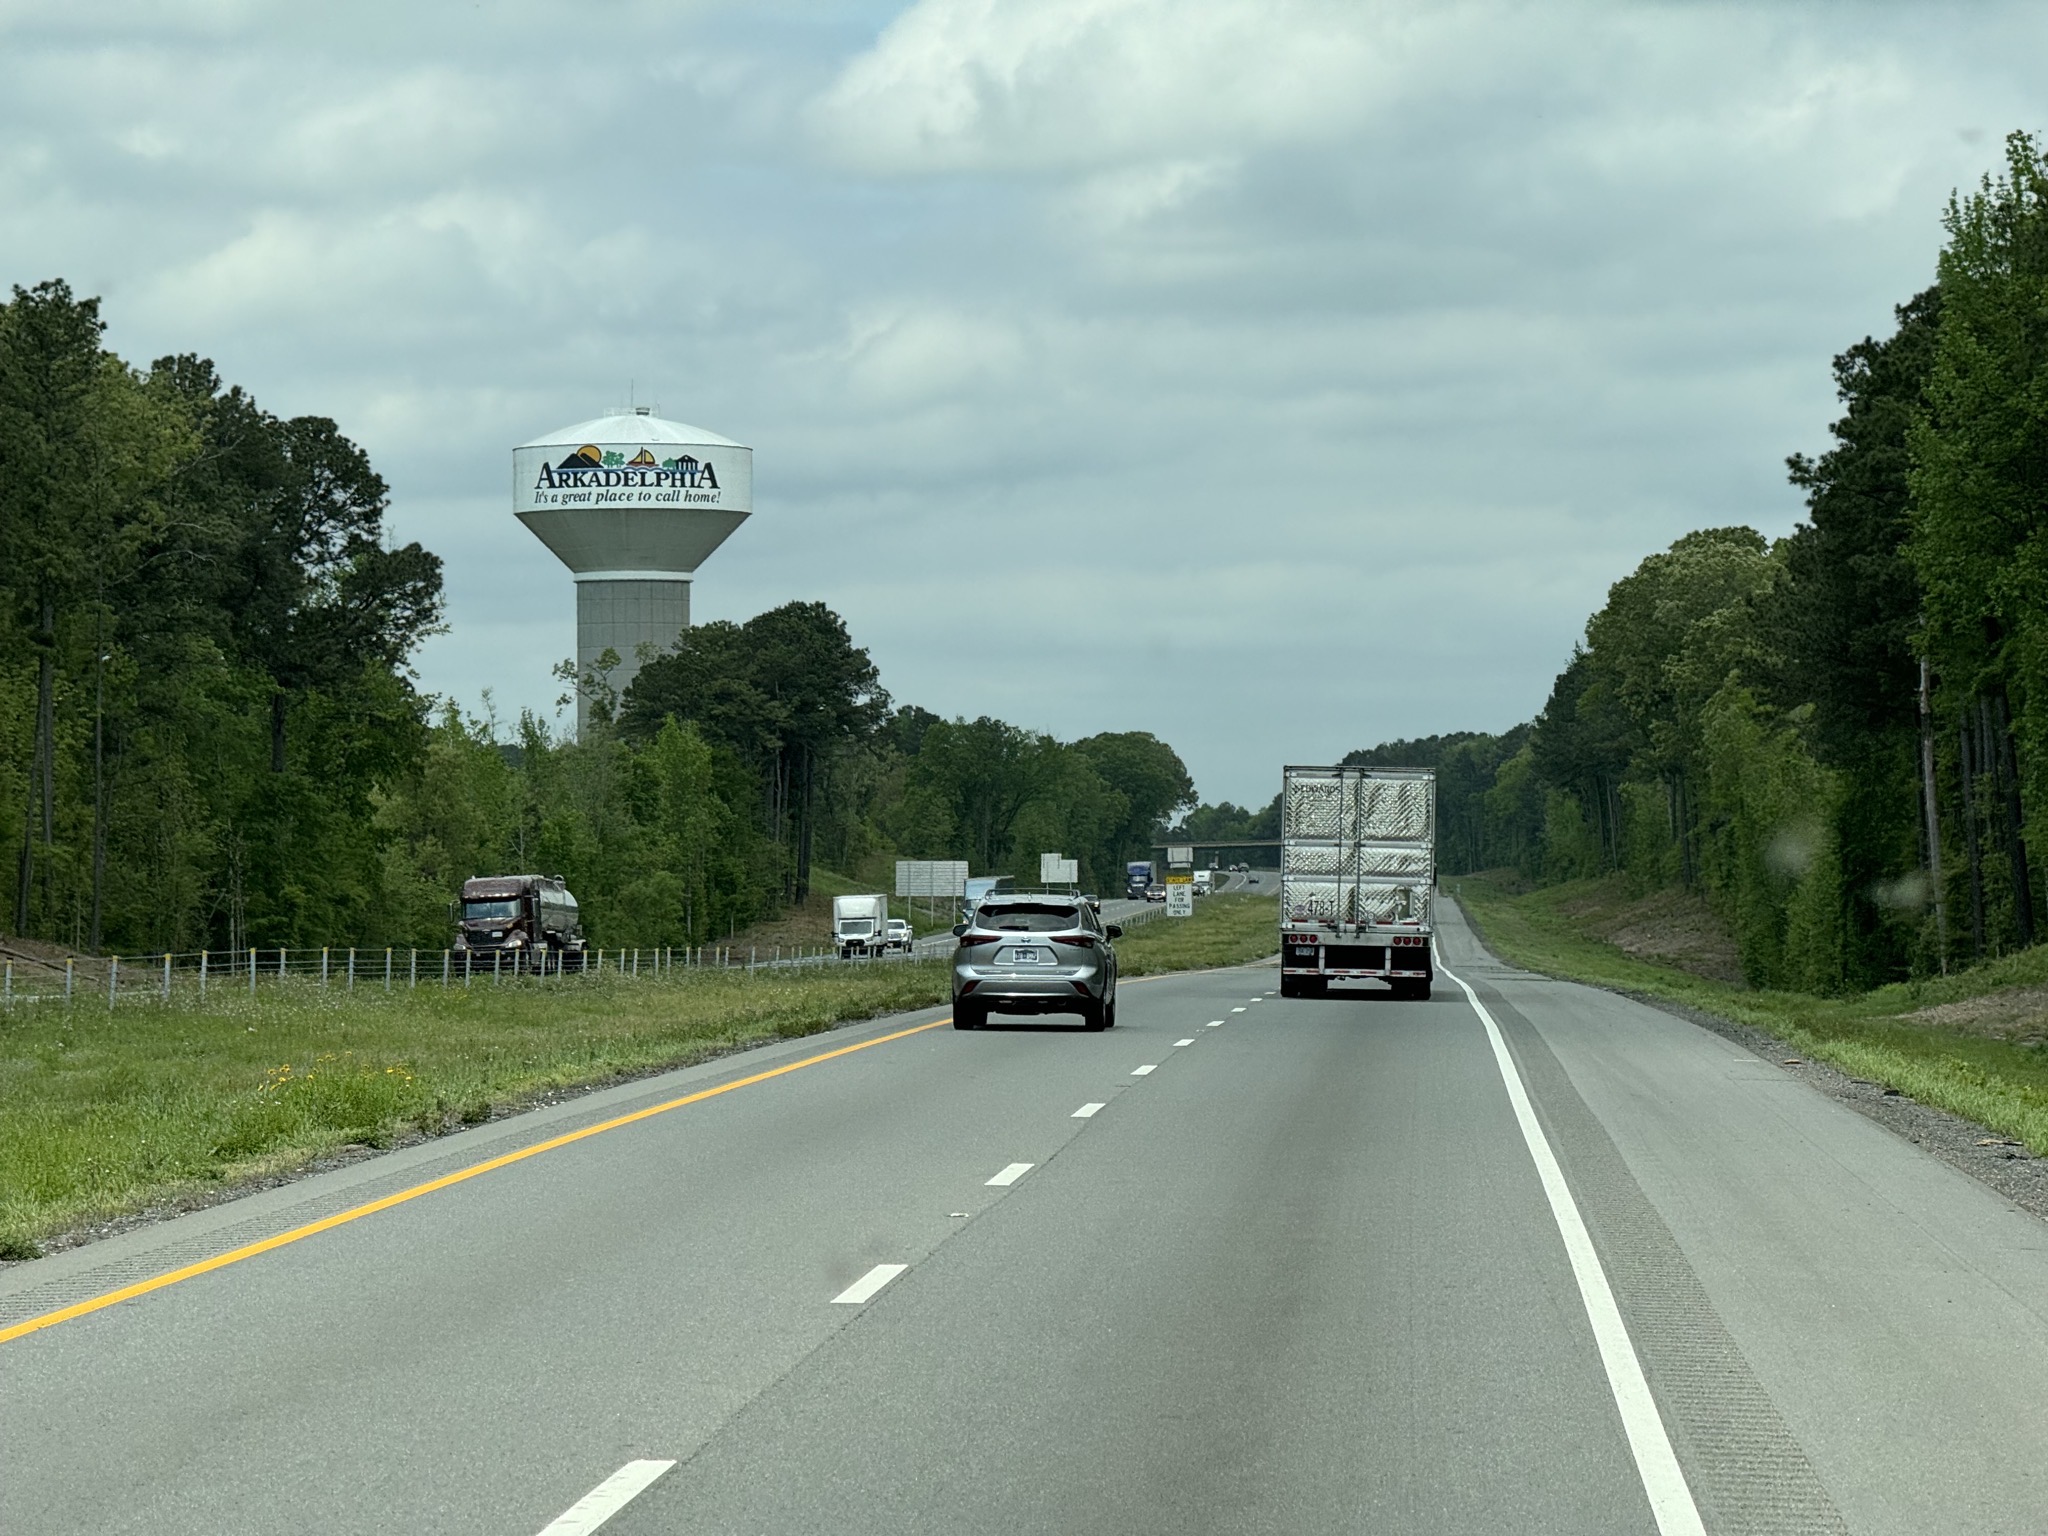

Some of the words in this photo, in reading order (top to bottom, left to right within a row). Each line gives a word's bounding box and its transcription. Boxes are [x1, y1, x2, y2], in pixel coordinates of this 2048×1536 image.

[534, 461, 721, 489] ARKADELPHIA
[534, 491, 548, 504] It's
[551, 493, 558, 503] a
[561, 490, 592, 506] great
[595, 489, 634, 505] place
[638, 491, 652, 502] to
[655, 490, 681, 502] call
[684, 490, 721, 504] home!
[1308, 900, 1334, 915] 478-T
